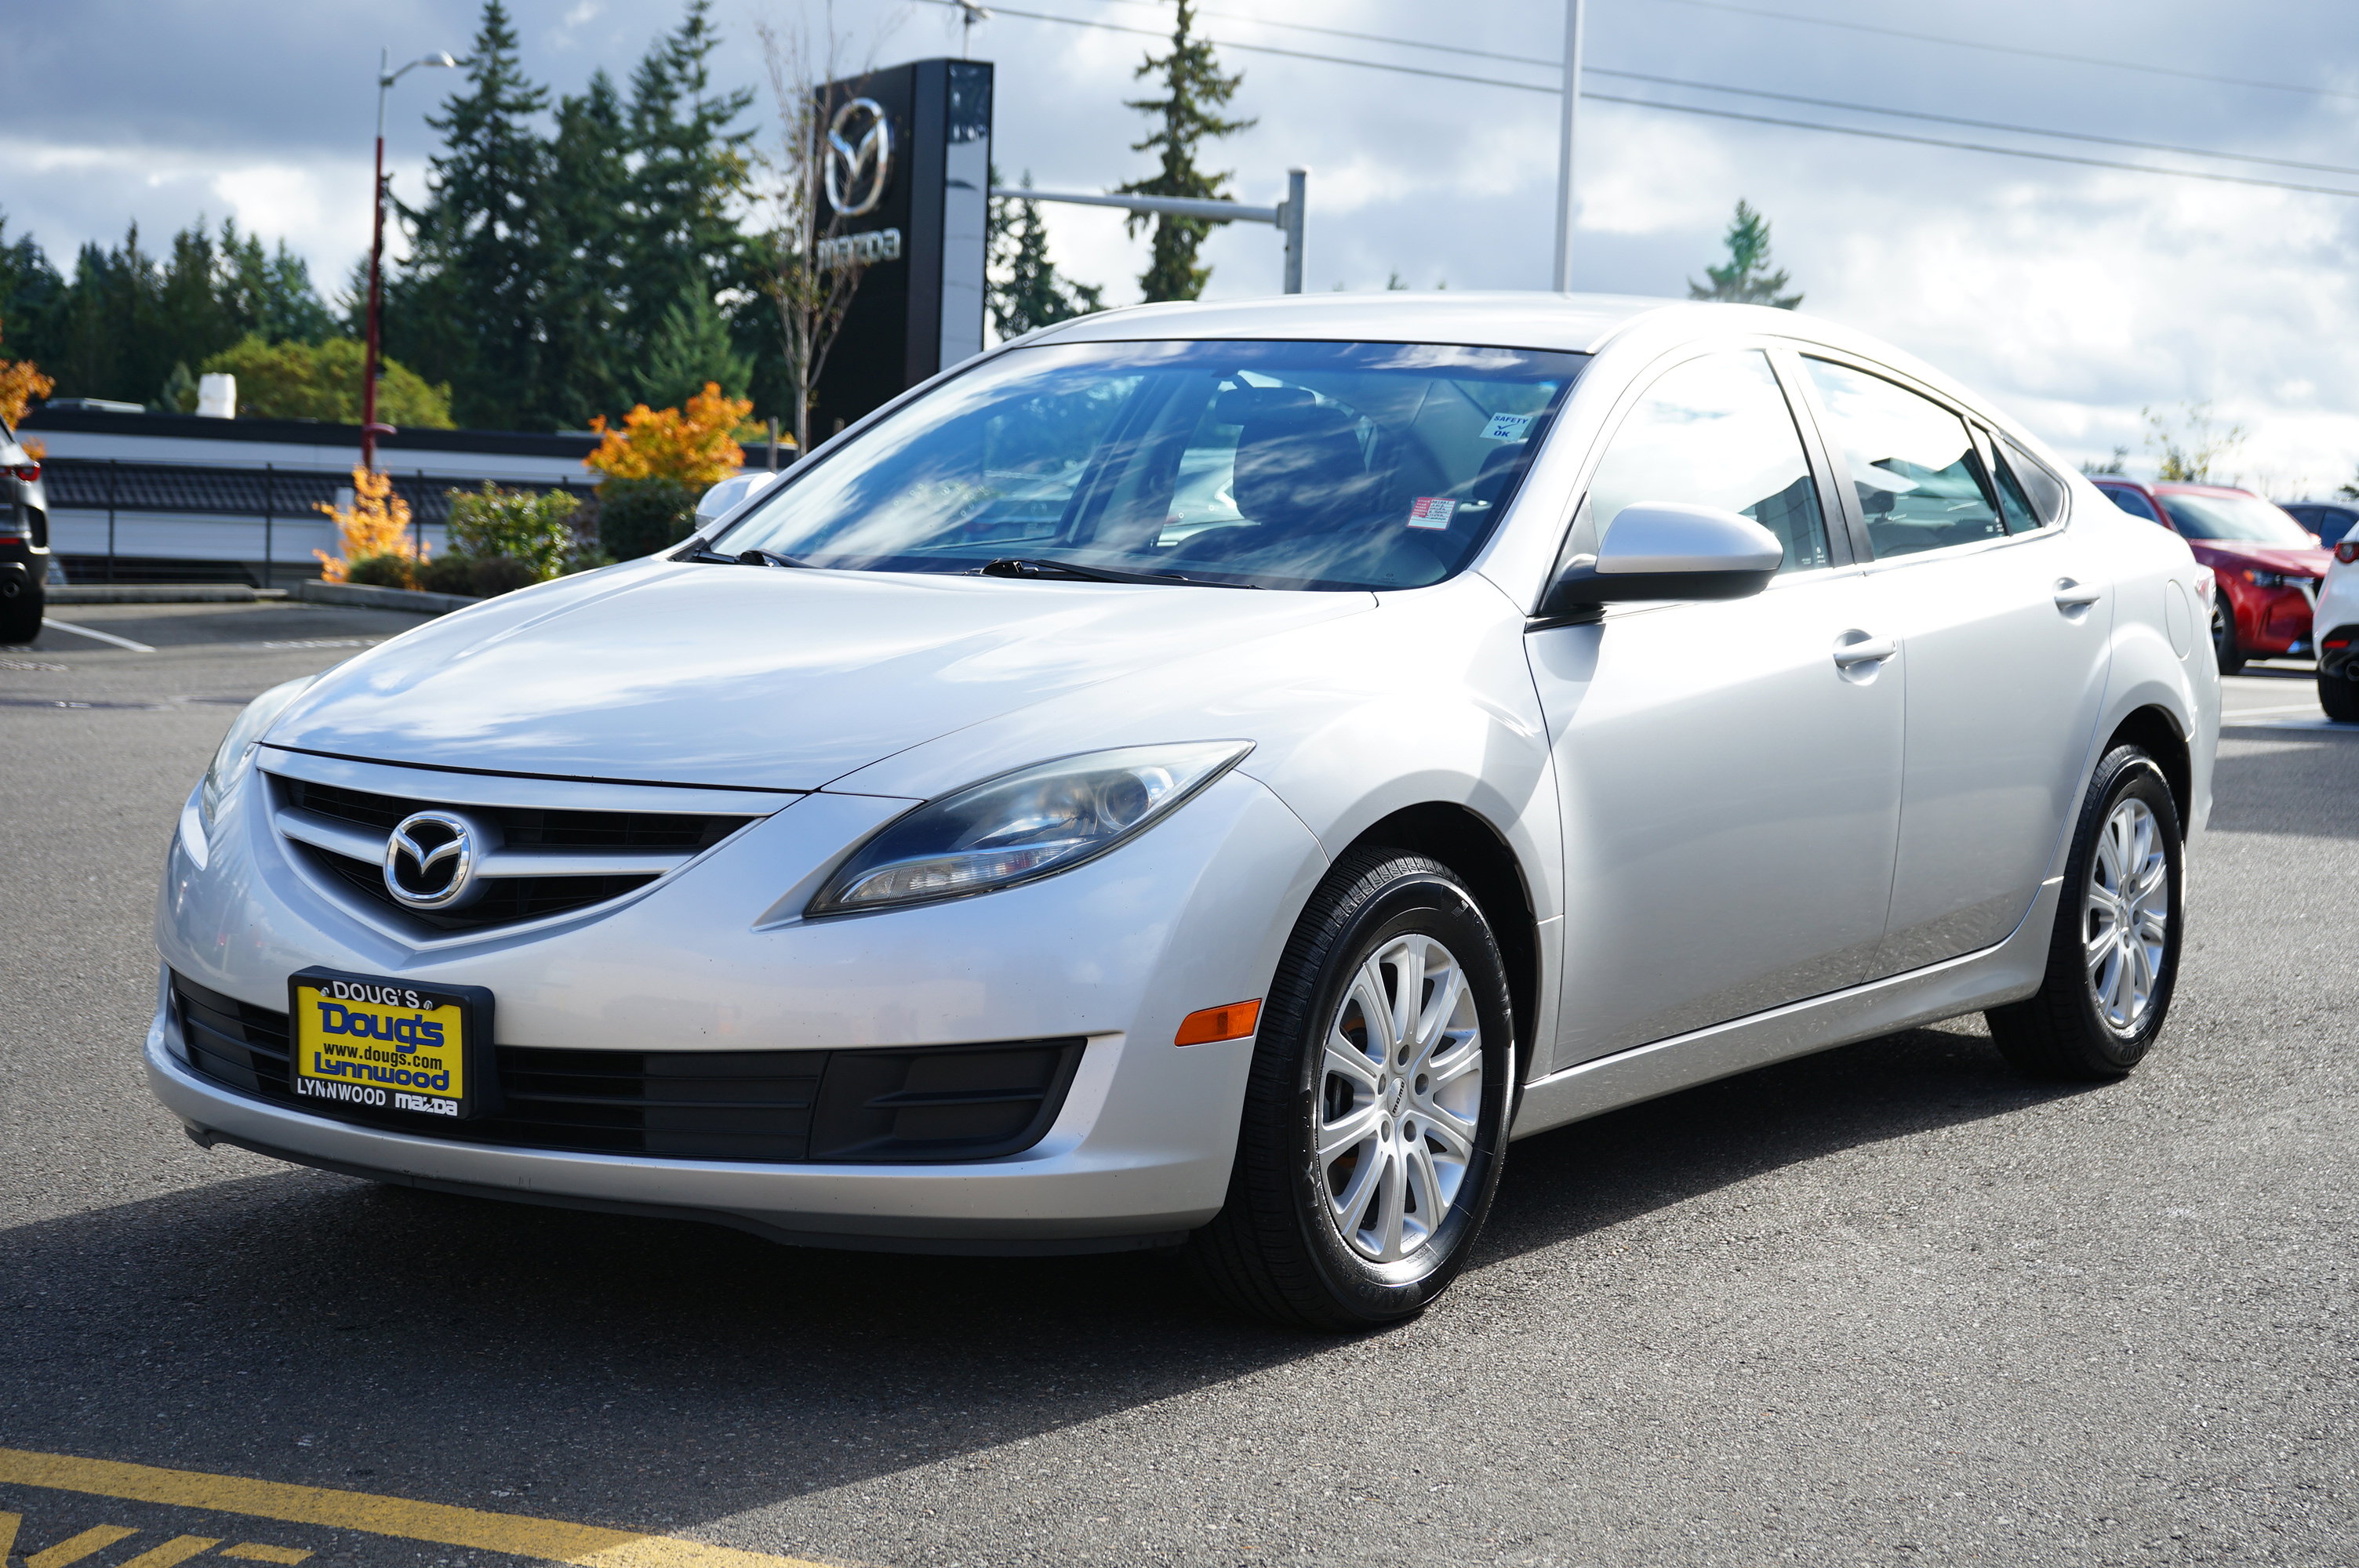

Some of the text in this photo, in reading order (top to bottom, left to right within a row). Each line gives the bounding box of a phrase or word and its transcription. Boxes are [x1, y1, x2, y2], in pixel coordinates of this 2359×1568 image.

[1494, 416, 1528, 424] SAFETY
[333, 981, 420, 1009] DOUG'S
[317, 1001, 445, 1054] Doug's
[314, 1051, 449, 1091] Lynnwood
[323, 1043, 443, 1071] www.dougs.com
[297, 1077, 387, 1106] LYNNWOOD
